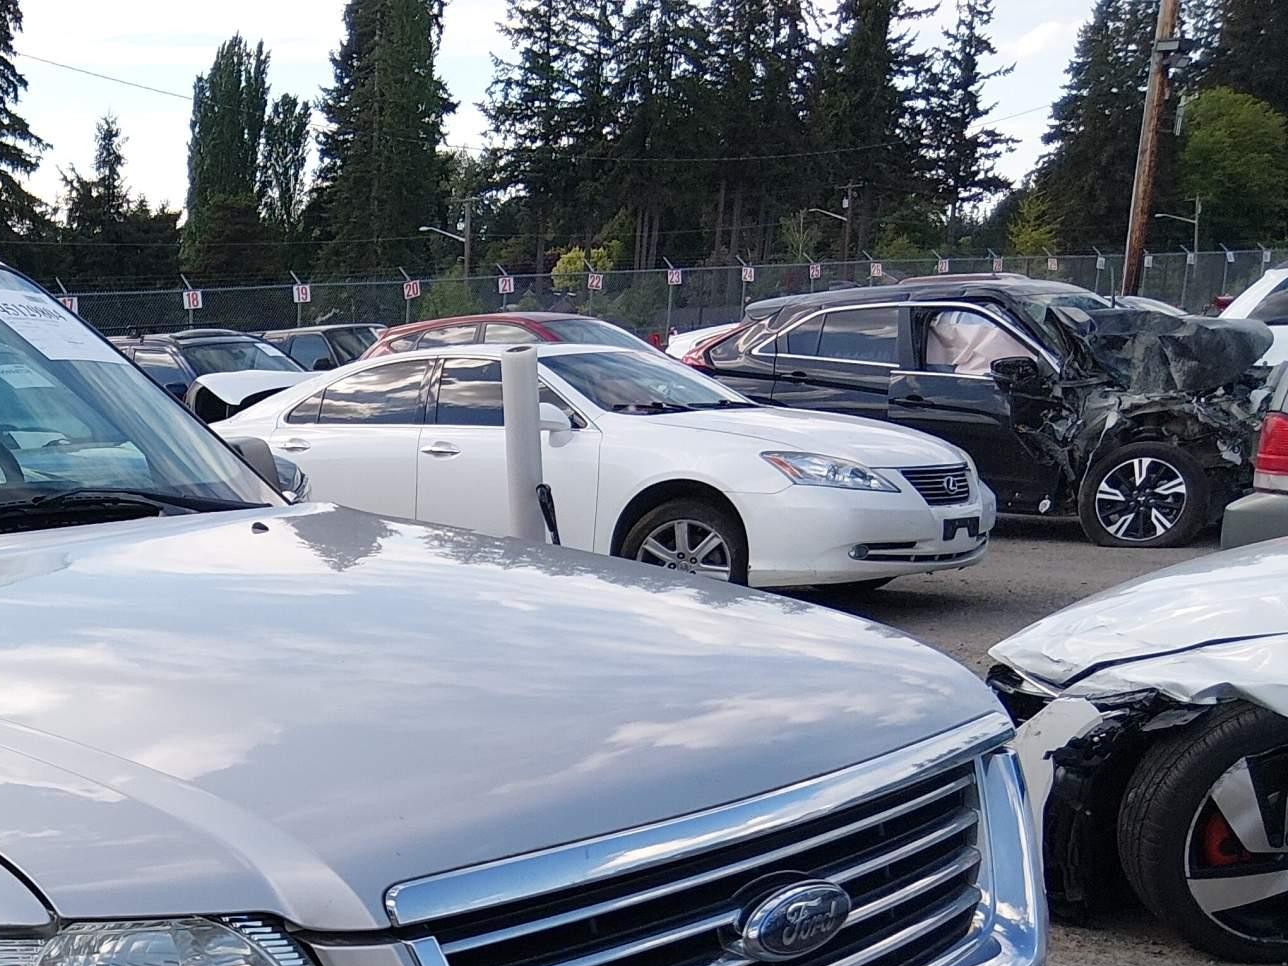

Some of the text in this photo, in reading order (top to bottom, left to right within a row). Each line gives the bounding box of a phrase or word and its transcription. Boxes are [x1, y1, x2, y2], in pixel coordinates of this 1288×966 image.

[669, 271, 680, 284] 23
[743, 268, 753, 281] 24
[811, 265, 820, 278] 25
[501, 278, 512, 292] 21
[589, 275, 601, 288] 22
[296, 287, 308, 302] 19
[404, 282, 419, 297] 20
[186, 292, 199, 308] 18
[782, 897, 836, 946] Ford
